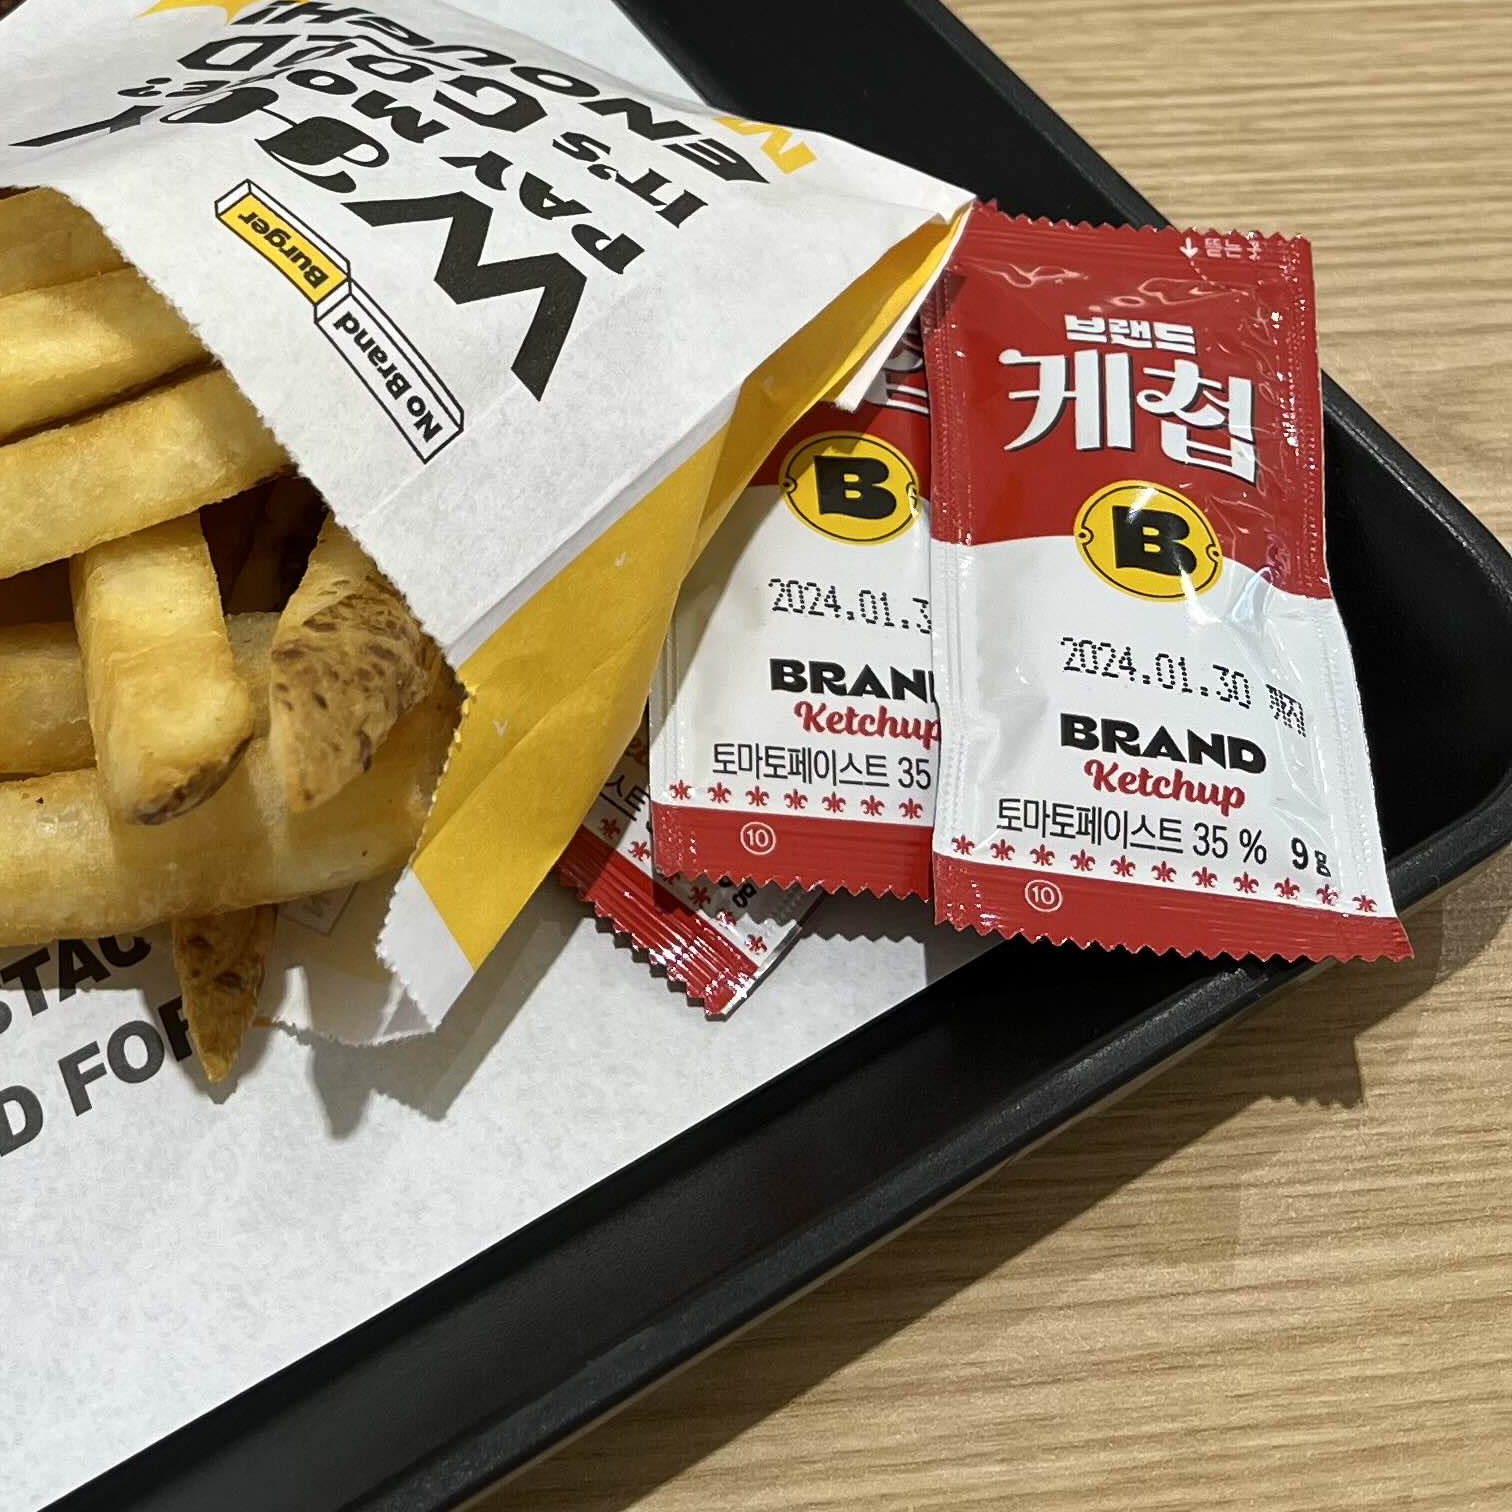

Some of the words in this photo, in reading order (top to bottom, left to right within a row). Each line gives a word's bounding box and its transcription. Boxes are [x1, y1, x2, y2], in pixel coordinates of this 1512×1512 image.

[230, 0, 770, 184] ENOUGH!
[552, 130, 708, 228] IT'S
[439, 150, 645, 275] PAY
[238, 210, 329, 289] Burger
[333, 311, 411, 400] Brand
[1064, 314, 1197, 355] 브랜드
[407, 395, 443, 443] No
[998, 349, 1257, 488] 케첩
[814, 454, 895, 521] B
[1112, 505, 1197, 576] B
[768, 578, 931, 634] 2024.01.3
[770, 658, 935, 703] BRAN
[1061, 637, 1251, 709] 2024.01.30
[794, 701, 941, 750] Ketchup
[1060, 713, 1267, 774] BRAND
[712, 743, 889, 787] 토마토페이스트
[897, 756, 932, 790] 35
[1084, 759, 1246, 817] Ketchup
[997, 798, 1184, 854] 토마토페이스트
[1192, 822, 1228, 858] 35
